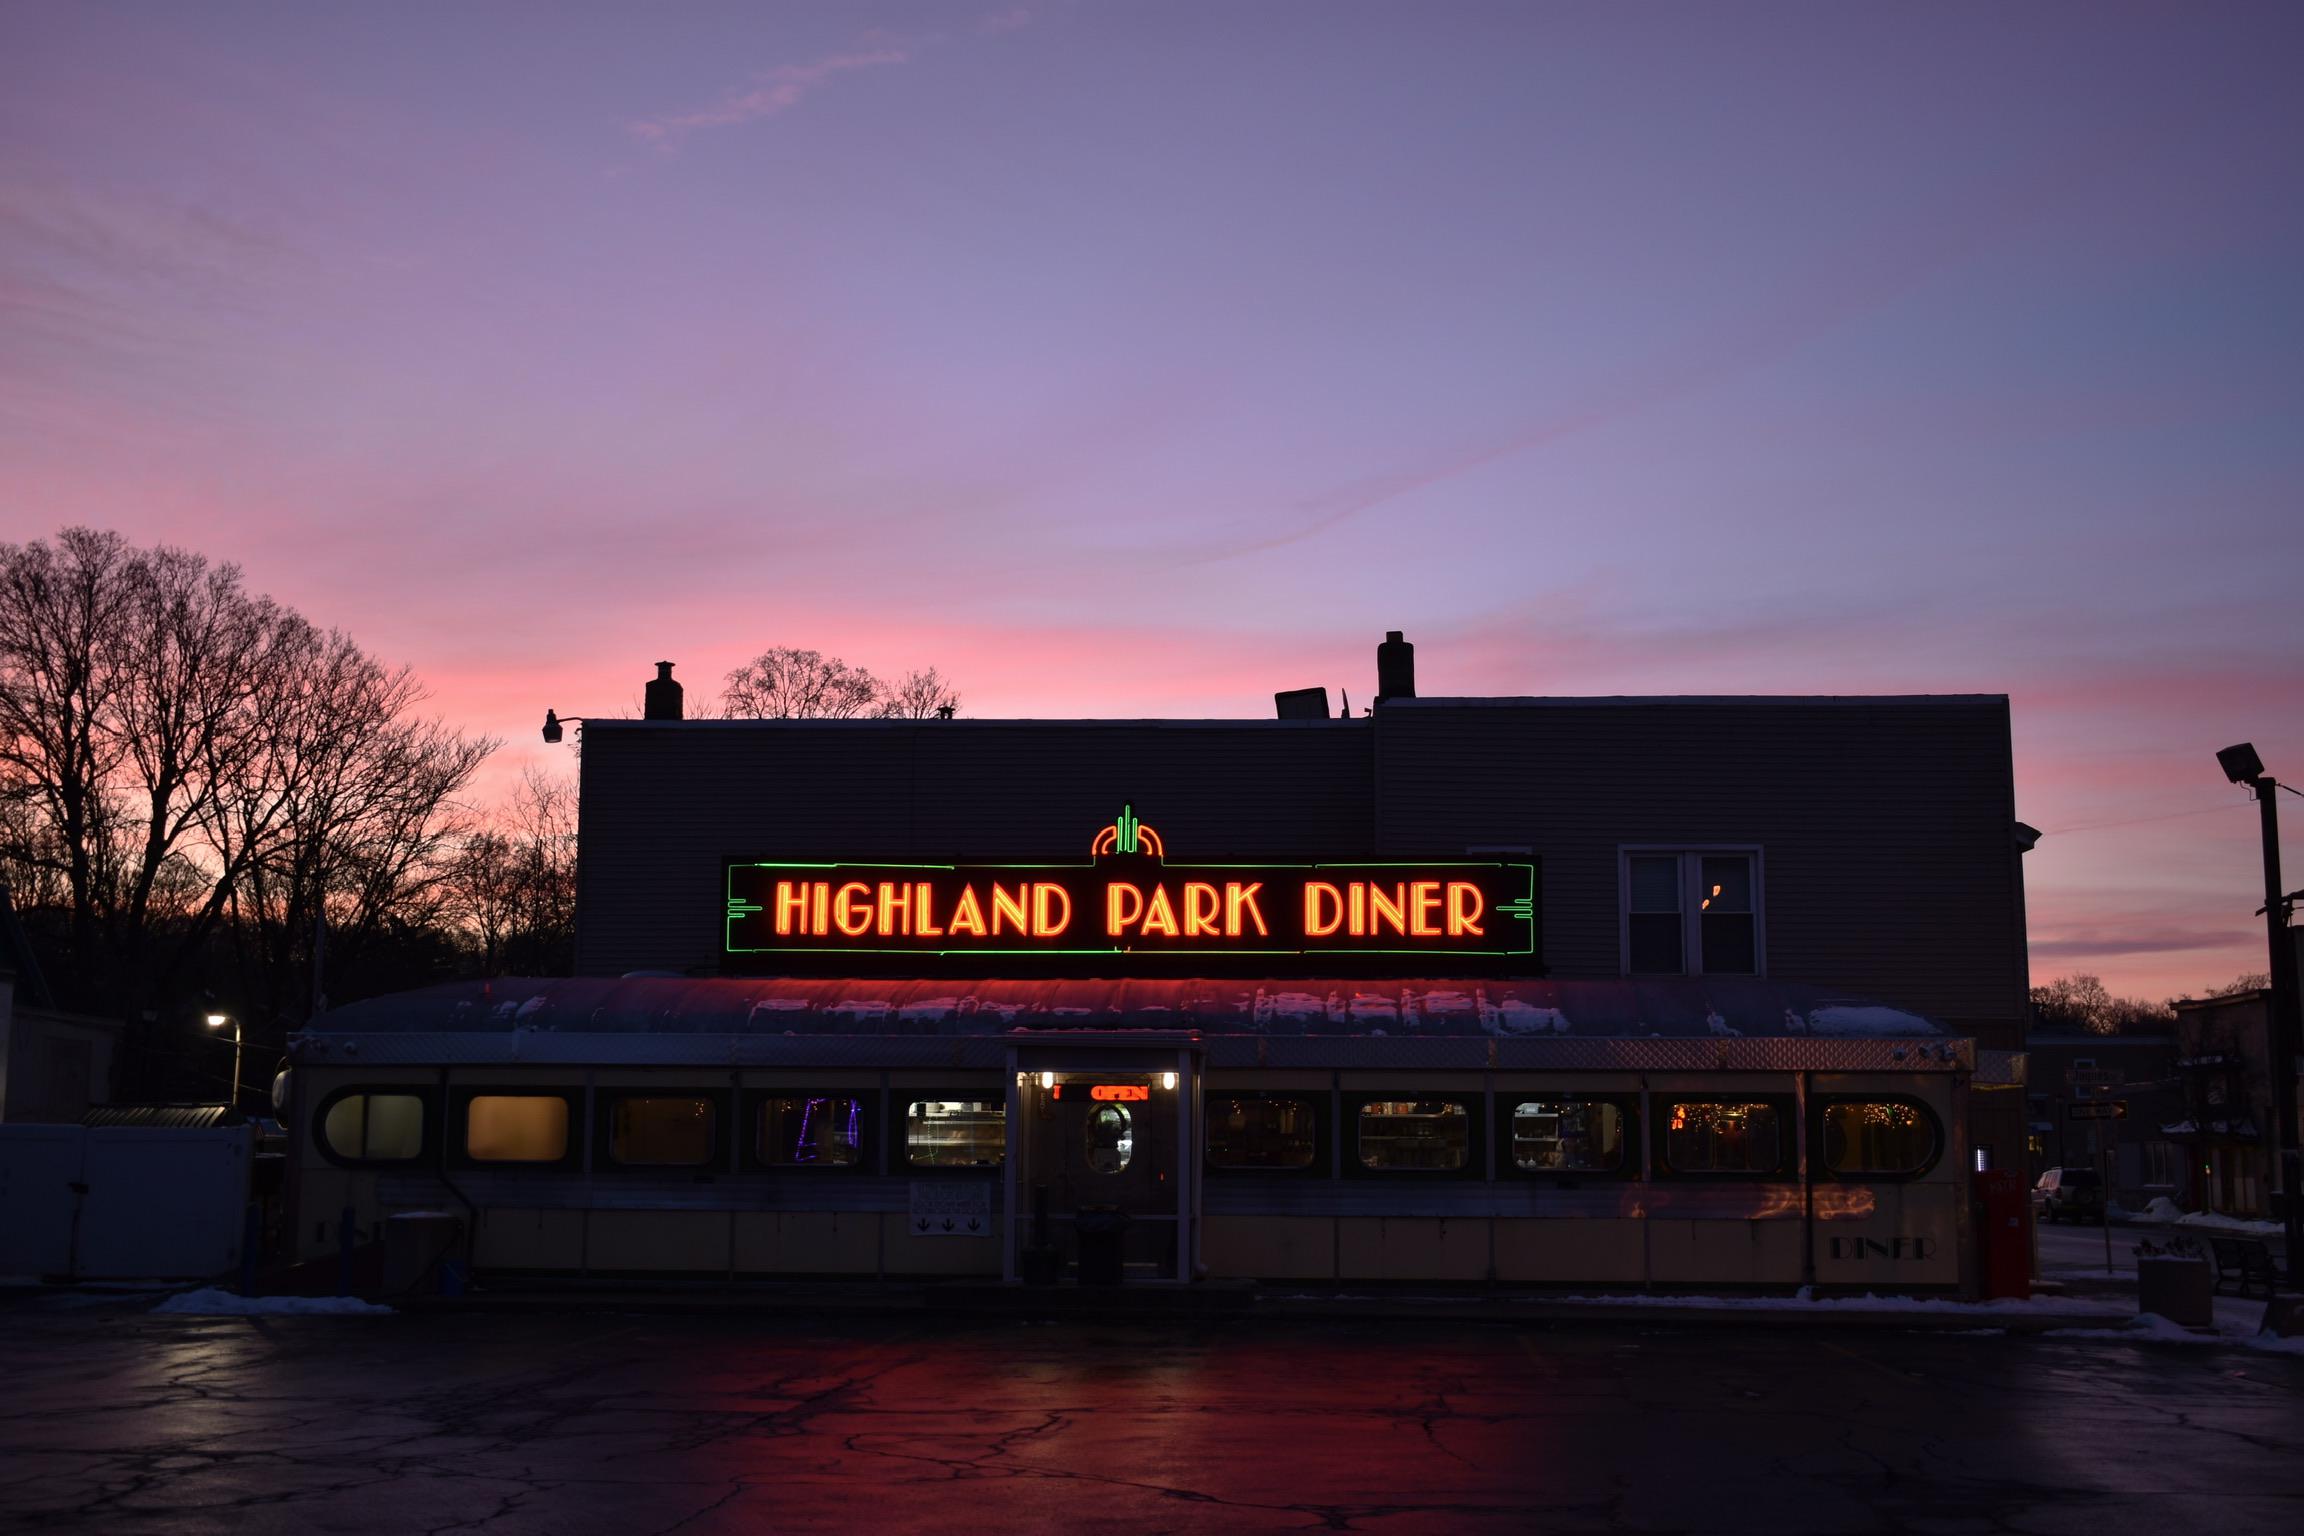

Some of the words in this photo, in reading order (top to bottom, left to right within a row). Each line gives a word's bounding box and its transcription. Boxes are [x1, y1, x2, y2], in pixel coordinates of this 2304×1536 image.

[775, 881, 1071, 937] HIGHLAND
[1106, 881, 1267, 937] PARK
[1304, 881, 1484, 937] DINER
[1090, 1085, 1149, 1101] OPEN
[1830, 1236, 1936, 1260] DINER
